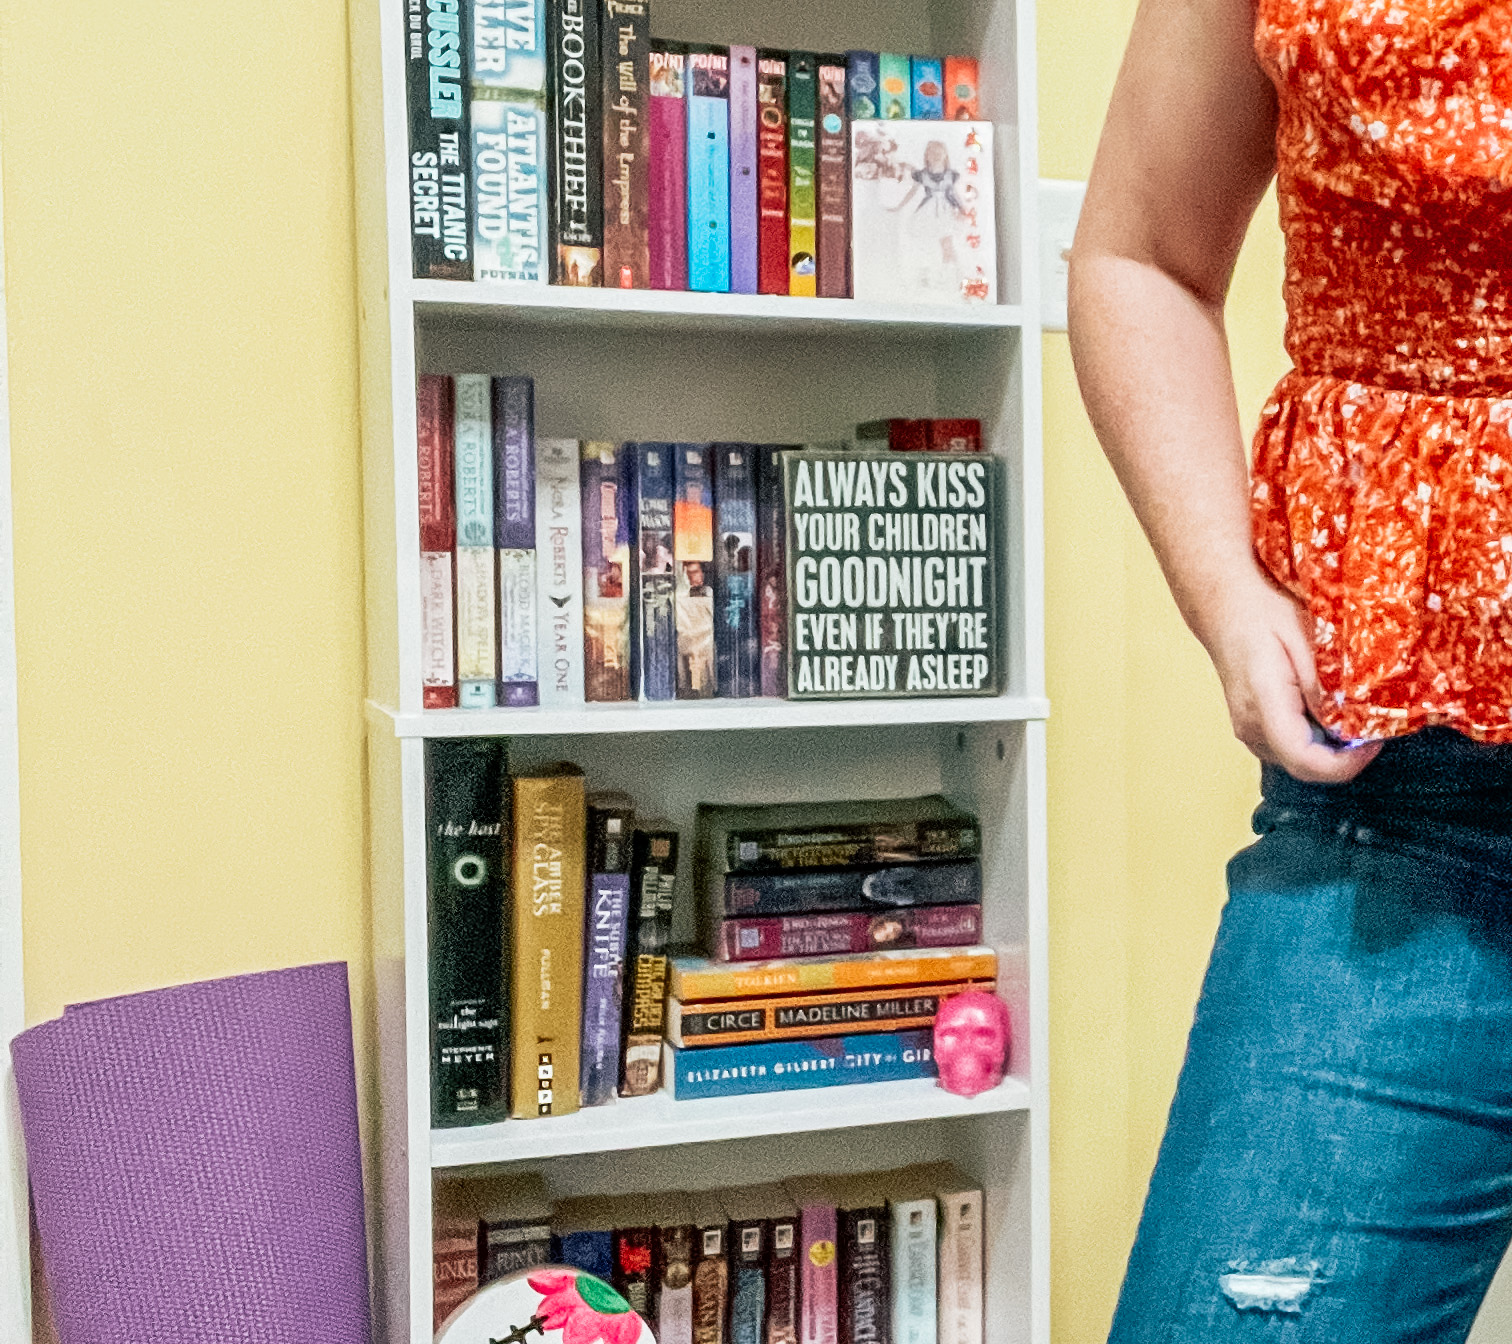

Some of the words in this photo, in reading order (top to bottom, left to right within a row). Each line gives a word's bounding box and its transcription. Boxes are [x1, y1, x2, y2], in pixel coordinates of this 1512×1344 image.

[562, 11, 586, 109] BOOK
[619, 24, 637, 56] The
[616, 60, 637, 92] Will
[611, 95, 638, 116] of
[439, 132, 460, 167] THE
[620, 119, 637, 147] the
[563, 111, 588, 213] THIEF
[412, 150, 440, 240] SECRET
[476, 131, 508, 242] FOUND
[507, 111, 539, 264] ATLANTIS
[611, 152, 635, 225] Empress
[442, 172, 468, 261] TITANIC
[480, 269, 539, 282] PUTNAM
[419, 444, 433, 523] ROBERTS
[462, 441, 477, 516] ROBERTS
[505, 444, 521, 522] ROBERTS
[794, 460, 908, 507] ALWAYS
[917, 461, 986, 508] KISS
[794, 512, 861, 552] YOUR
[868, 512, 987, 552] CHILDREN
[429, 568, 443, 610] DARK
[796, 556, 987, 608] GOODNIGHT
[430, 615, 444, 670] WITCH
[795, 613, 857, 651] EVEN
[864, 613, 884, 650] IF
[891, 612, 988, 650] THEY'RE
[797, 655, 899, 692] ALREADY
[906, 654, 989, 691] ASLEEP
[437, 820, 465, 837] the
[468, 819, 501, 837] host
[549, 846, 563, 914] AMBER
[611, 888, 623, 917] THE
[593, 889, 613, 979] KNIFE
[633, 954, 652, 1029] COMPASS
[736, 973, 797, 989] TOLKIEN
[707, 1012, 761, 1031] CIRCE
[779, 1004, 870, 1025] MADELINE
[876, 998, 935, 1018] MILLER
[441, 1053, 494, 1064] MEYER
[687, 1064, 767, 1083] ELIZABETH
[774, 1057, 836, 1075] GILBERT
[845, 1052, 882, 1069] CITY
[902, 1047, 932, 1064] GIR
[434, 1258, 477, 1278] UNKE
